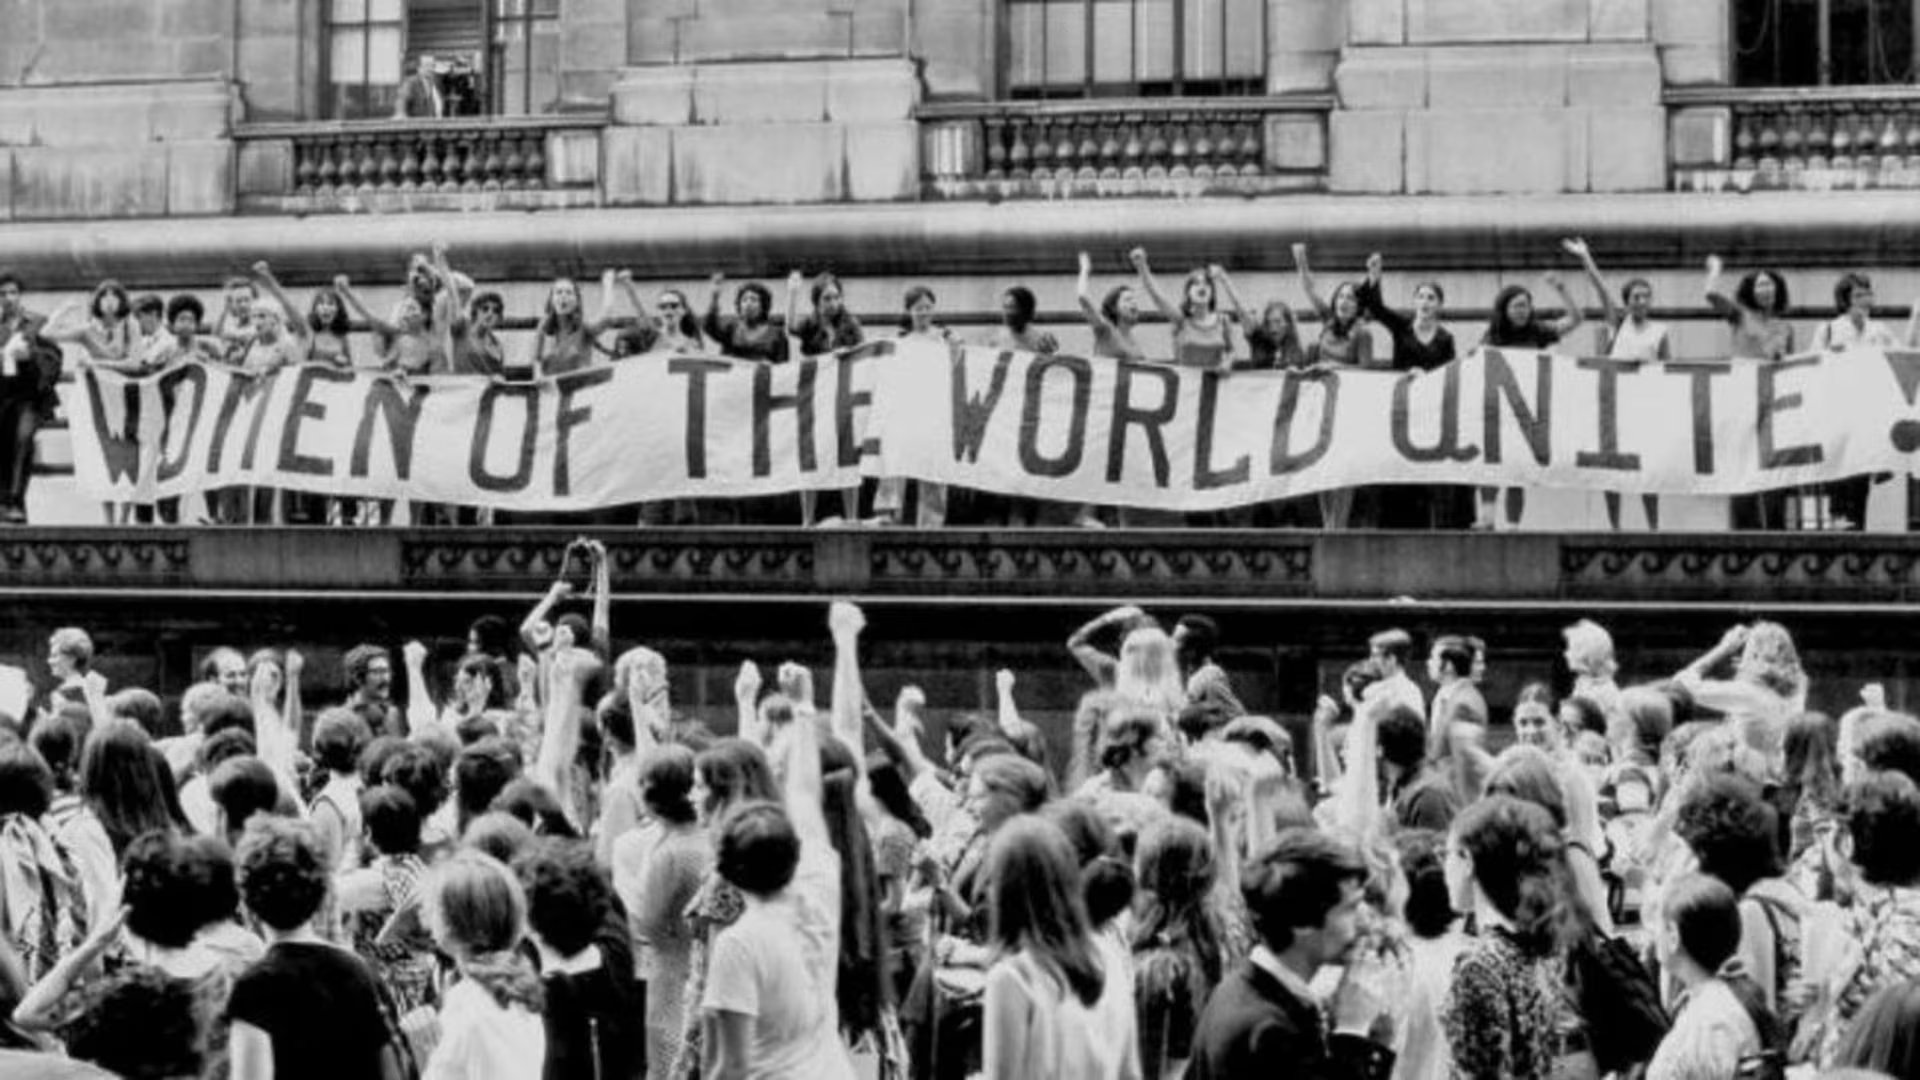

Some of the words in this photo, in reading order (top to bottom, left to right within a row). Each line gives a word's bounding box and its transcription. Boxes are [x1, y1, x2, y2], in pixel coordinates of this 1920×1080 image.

[85, 362, 430, 485] WOMEN
[470, 368, 613, 495] OF
[668, 342, 894, 478] THE
[952, 350, 1340, 488] WORLD
